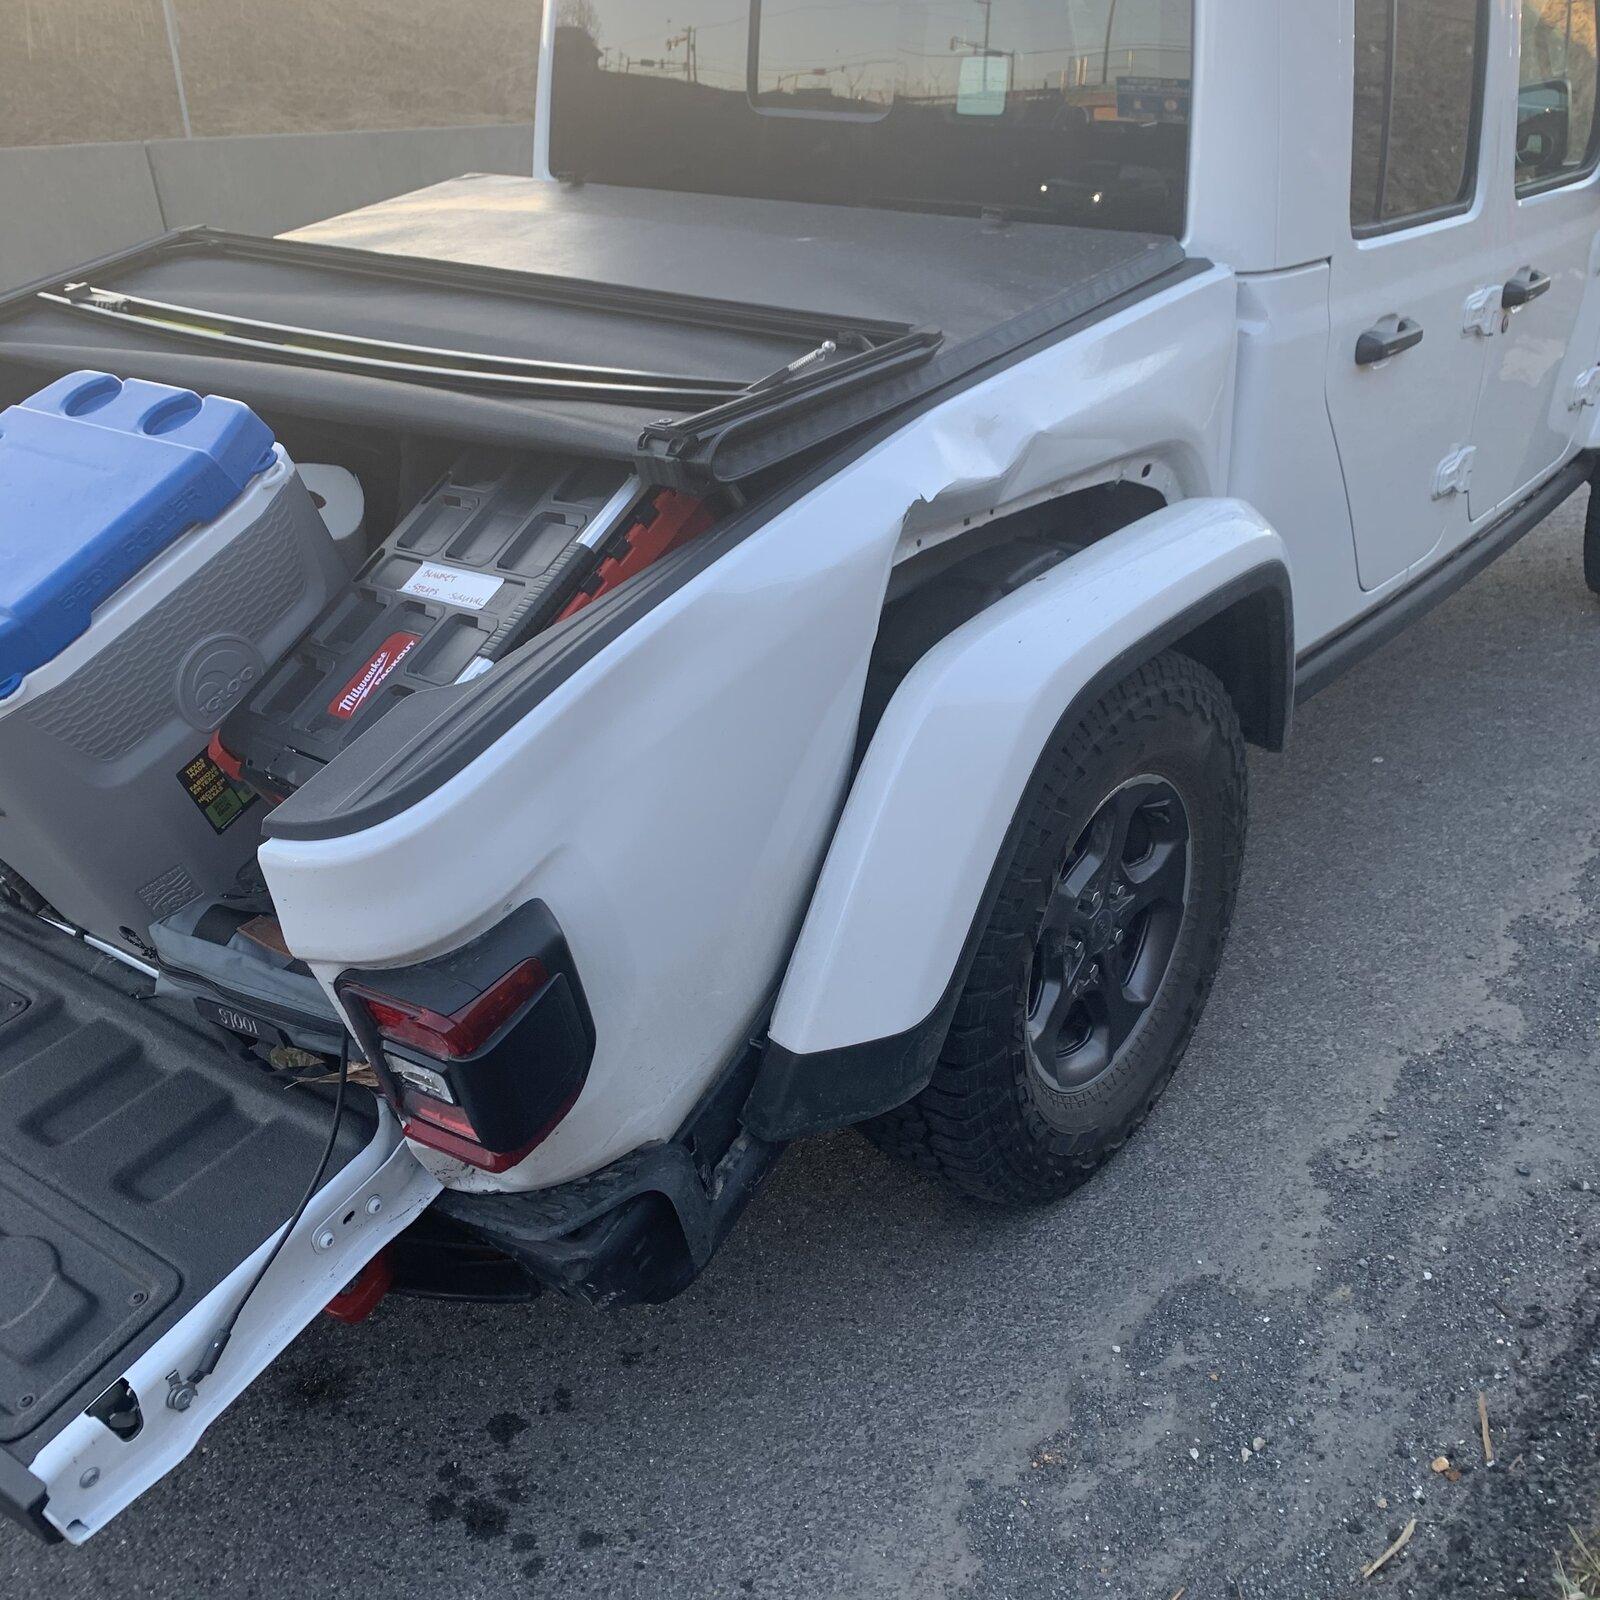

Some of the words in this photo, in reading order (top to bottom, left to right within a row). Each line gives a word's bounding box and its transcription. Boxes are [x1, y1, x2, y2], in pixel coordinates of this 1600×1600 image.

[121, 485, 201, 557] ROLLER
[375, 640, 415, 685] PACKOUT
[199, 666, 255, 717] IGLOO
[338, 650, 390, 714] Milwaukee
[186, 758, 205, 774] TEXAS
[189, 762, 206, 779] MADE
[197, 784, 217, 803] HECHO
[206, 785, 224, 802] TEXAS
